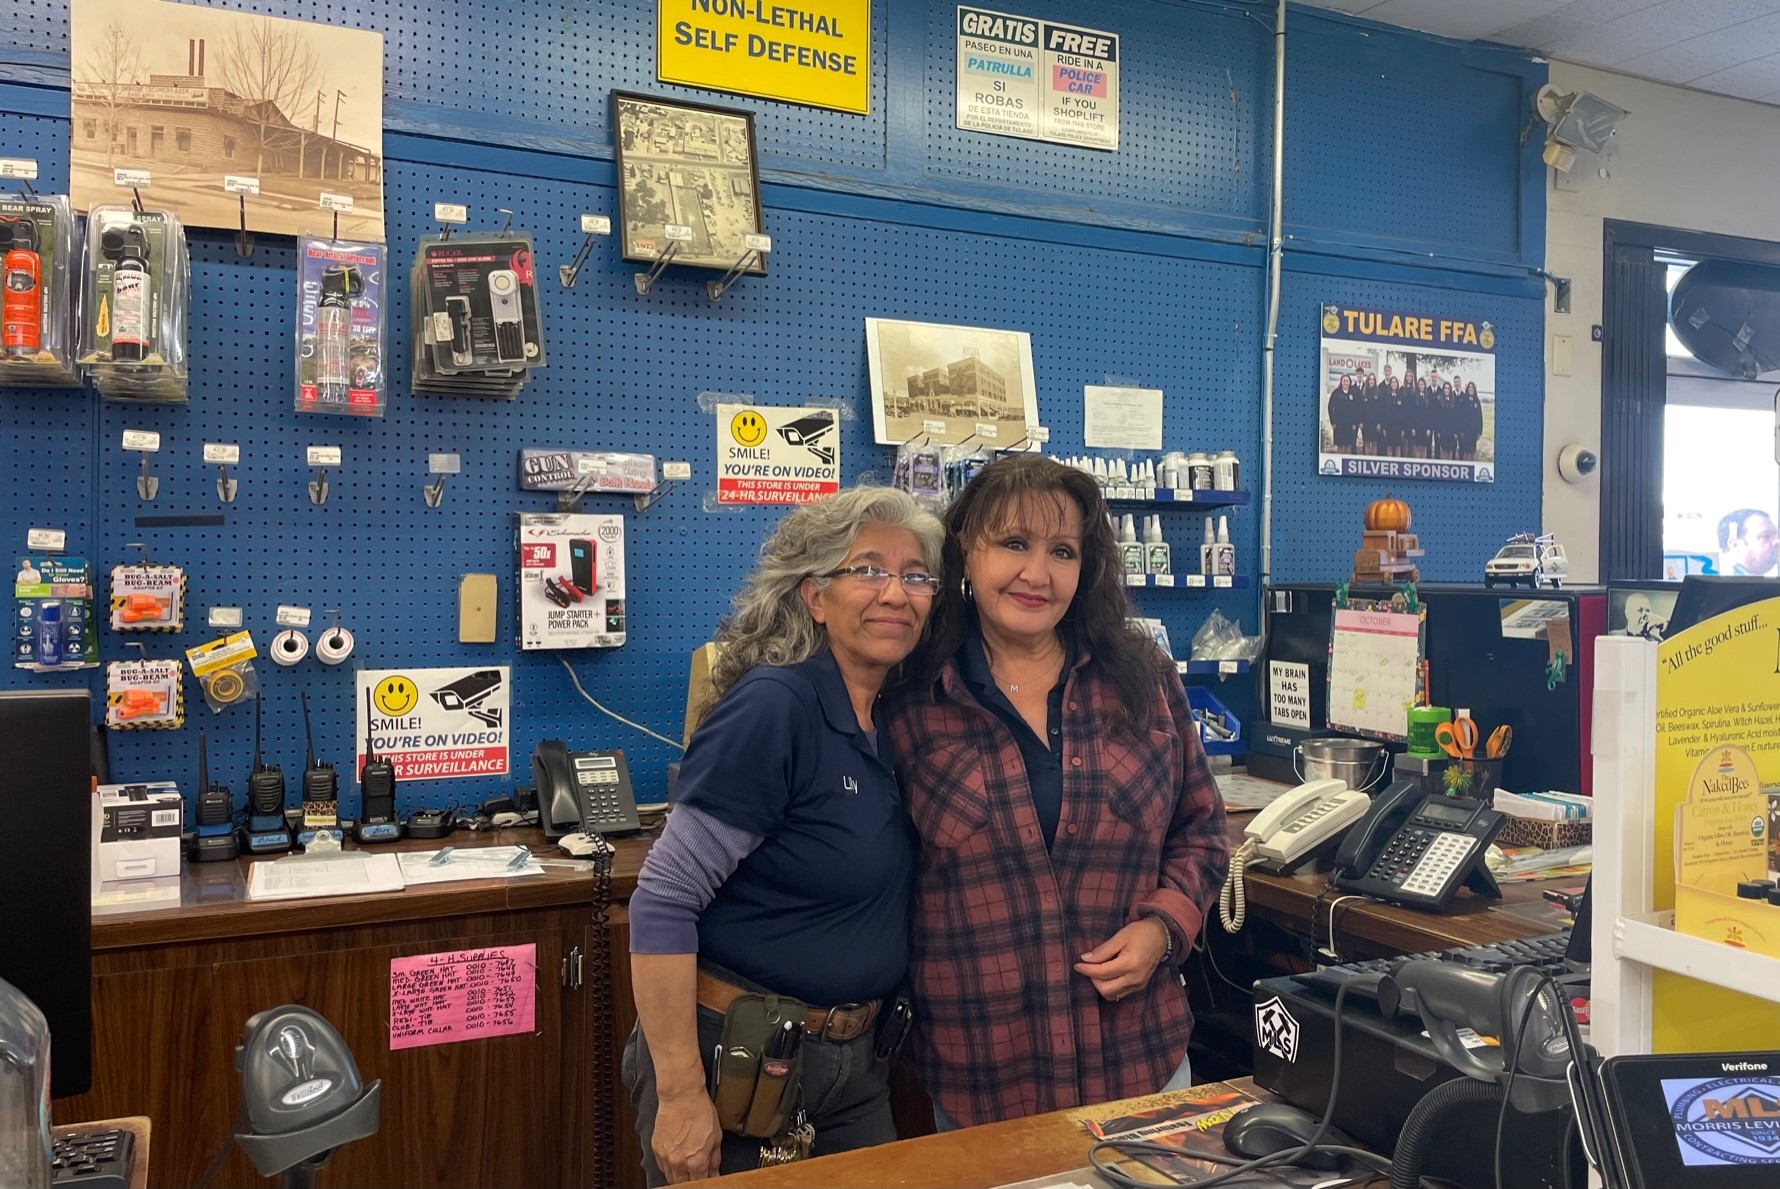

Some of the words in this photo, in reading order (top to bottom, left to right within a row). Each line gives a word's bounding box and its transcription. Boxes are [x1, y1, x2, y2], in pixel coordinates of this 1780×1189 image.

[692, 0, 843, 38] NON-LETHAL
[962, 13, 1035, 44] GRATIS
[674, 21, 738, 52] SELF
[748, 34, 856, 75] DEFENSE
[965, 41, 996, 53] PASEO
[999, 46, 1011, 55] EN
[1014, 49, 1032, 59] UNA
[1050, 30, 1111, 58] FREE
[968, 58, 1031, 78] PATRULLA
[1058, 55, 1080, 67] RIDE
[1084, 58, 1093, 68] IN
[1096, 62, 1103, 70] A
[1060, 68, 1101, 84] POLICE
[994, 81, 1006, 92] SI
[1068, 82, 1092, 94] CAR
[975, 93, 1023, 109] ROBAS
[1062, 96, 1071, 105] IF
[1075, 98, 1096, 110] YOU
[981, 107, 1000, 116] ESTA
[1002, 110, 1029, 120] TIENDA
[1054, 108, 1104, 123] SHOPLIFT
[988, 117, 1031, 127] DEPARTAMENTO
[1344, 311, 1433, 341] TULARE
[1440, 321, 1477, 345] FFA
[729, 448, 770, 459] SMILE!
[525, 453, 570, 474] GUN
[1348, 461, 1398, 476] SILVER
[1404, 464, 1469, 479] SPONSOR
[528, 471, 574, 484] CONTROL
[724, 464, 769, 476] YOU'RE
[772, 466, 790, 476] ON
[795, 467, 835, 479] VIDEO!
[737, 481, 755, 489] THIS
[722, 491, 755, 500] 24-HR
[602, 526, 618, 535] 2000
[534, 546, 551, 559] 50x
[548, 611, 565, 619] JUMP
[567, 610, 592, 618] STARTER
[1360, 616, 1391, 626] OCTOBER
[548, 620, 570, 629] POWER
[572, 620, 589, 628] PACK
[1685, 643, 1702, 661] the
[1705, 624, 1732, 655] good
[1273, 667, 1282, 677] MY
[1285, 668, 1306, 679] BRAIN
[1282, 682, 1297, 692] HAS
[1274, 694, 1286, 703] TOO
[1288, 695, 1306, 707] MANY
[1274, 707, 1289, 717] TABS
[1291, 709, 1306, 720] OPEN
[1679, 707, 1705, 719] Organic
[1707, 706, 1722, 715] Aloe
[1724, 704, 1739, 714] Vera
[1741, 704, 1746, 712] &
[371, 718, 421, 731] SMILE!
[1734, 717, 1752, 726] Witch
[425, 735, 448, 746] ON
[452, 732, 502, 745] VIDEO!
[1704, 734, 1708, 742] &
[1710, 732, 1744, 743] Hyaluronic
[1747, 730, 1761, 738] Acid
[1752, 743, 1756, 751] E
[382, 754, 403, 762] THIS
[405, 752, 437, 762] STORE
[451, 750, 484, 759] UNDER
[406, 760, 504, 775] SURVEILLANCE
[393, 1029, 424, 1038] UNIFORM
[1721, 1062, 1768, 1071] Verifone
[1706, 1077, 1772, 1089] ELECTRICAL
[1703, 1098, 1780, 1118] ML
[1138, 1121, 1192, 1137] Featuring
[1677, 1122, 1741, 1131] MORRIS
[1684, 1134, 1756, 1164] CONTRACTING
